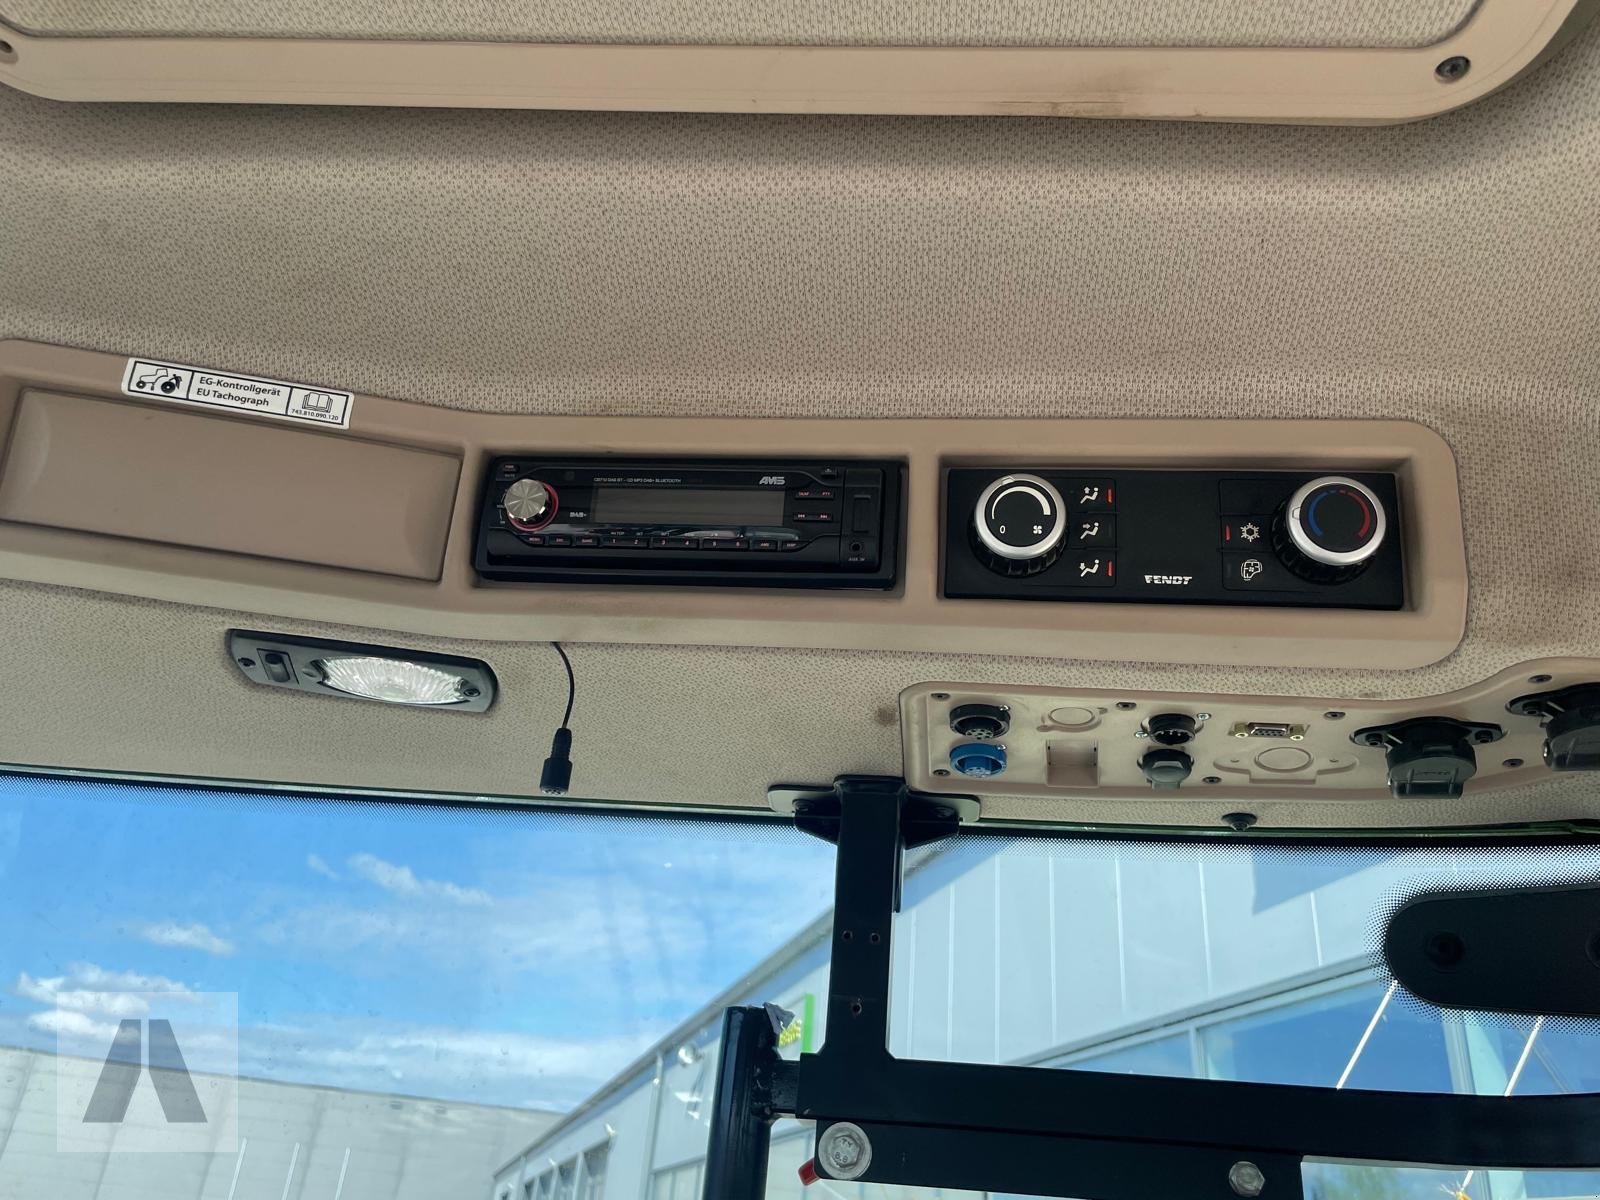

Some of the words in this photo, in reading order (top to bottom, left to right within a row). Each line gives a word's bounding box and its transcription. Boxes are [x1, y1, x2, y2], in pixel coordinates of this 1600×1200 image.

[199, 376, 281, 397] EG-Kontrollgerät
[196, 388, 210, 397] EU
[212, 390, 269, 407] Tachograph
[759, 476, 786, 485] AMS
[1144, 574, 1193, 585] FENDT
